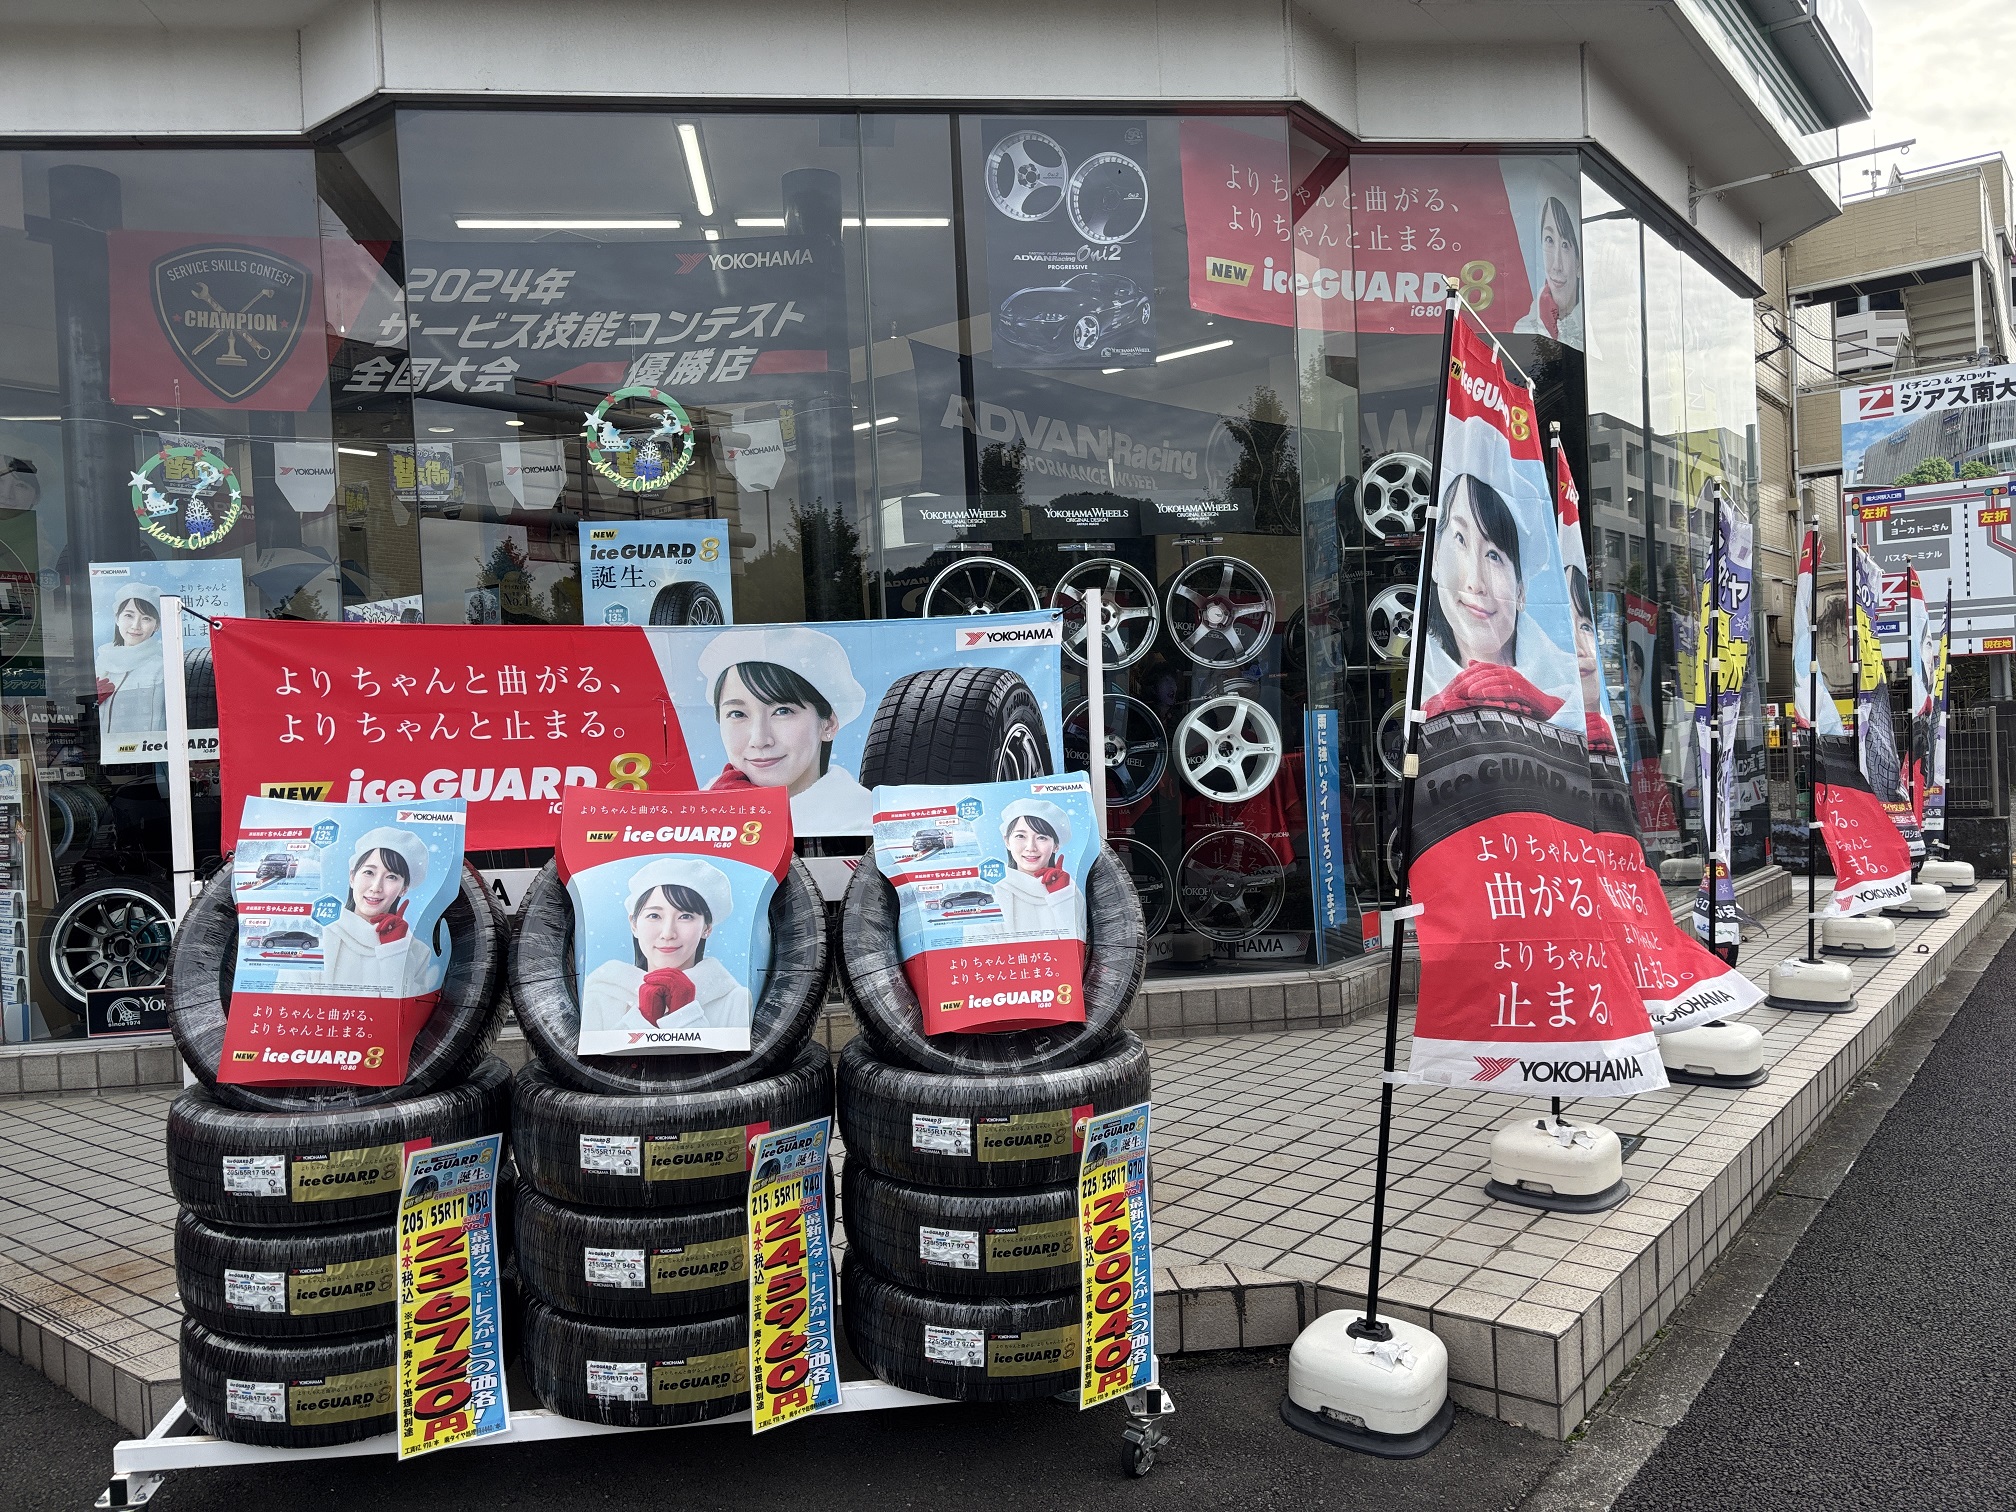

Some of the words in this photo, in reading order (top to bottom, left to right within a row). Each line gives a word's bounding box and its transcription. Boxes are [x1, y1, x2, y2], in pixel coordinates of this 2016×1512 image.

[1224, 164, 1461, 213] よりちゃんと曲がる、
[1227, 205, 1463, 252] よりちゃんと止まる。
[708, 249, 813, 271] YOKOHAMA
[167, 261, 210, 282] SERVICE
[211, 260, 247, 274] SKILLS
[249, 262, 295, 287] CONTEST
[393, 268, 577, 305] 2024年
[1211, 262, 1248, 281] NEW
[1262, 257, 1448, 303] iceGUARD
[1460, 260, 1496, 312] 8
[184, 310, 277, 331] CHAMPION
[1410, 305, 1442, 318] iG80
[373, 301, 806, 350] サービス技能コンテスト
[343, 356, 520, 393] 全国大会
[624, 347, 759, 388] 優勝店
[1900, 378, 1940, 391] パチンコ
[1944, 376, 1952, 385] &
[1955, 370, 1997, 382] スロット
[1511, 406, 1531, 441] 8
[739, 445, 781, 457] YOKOHAMA
[520, 465, 563, 474] YOKOHAMA
[588, 459, 630, 488] Merry
[633, 452, 695, 493] Christmas
[1862, 506, 1888, 519] 左折
[1890, 518, 1915, 526] イトー
[1981, 510, 2008, 523] 左折
[140, 521, 185, 549] Merry
[188, 504, 241, 550] Christmas
[1891, 523, 1949, 536] ヨーカドーさん
[590, 543, 697, 560] iceGUARD
[699, 538, 720, 562] 8
[1884, 551, 1942, 563] バスターミナル
[590, 564, 657, 590] 誕生。
[179, 584, 227, 593] よりちゃんと
[986, 629, 1053, 642] YOKOHAMA
[1983, 639, 2012, 649] 現在地
[275, 665, 622, 698] よりちゃんと曲がる、
[31, 713, 75, 724] ADVAN
[278, 709, 626, 744] よりちゃんと止まる。
[268, 787, 323, 801] NEW
[346, 766, 597, 803] iceGUARD
[609, 753, 652, 790] 8
[1044, 784, 1084, 792] YOKOHAMA
[412, 813, 454, 822] YOKOHAMA
[623, 825, 737, 843] iceGUARD
[739, 821, 763, 845] 8
[1477, 833, 1595, 864] よりちゃんと
[949, 952, 1059, 970] よりちゃんと曲がる、
[1493, 942, 1608, 970] よりちゃんと
[951, 968, 1060, 986] よりちゃんと止まる。
[943, 1002, 961, 1010] NEW
[968, 989, 1054, 1009] iceGUARD
[1057, 984, 1072, 1005] 8
[252, 1005, 374, 1022] よりちゃんと曲がる、
[250, 1023, 373, 1039] よりちゃんと止まる。
[645, 1032, 702, 1042] YOKOHAMA
[262, 1047, 362, 1065] iceGUARD
[363, 1046, 385, 1069] 8
[1519, 1056, 1643, 1082] YOKOHAMA
[984, 1133, 1052, 1148] iceGUARD
[1090, 1121, 1135, 1142] iceGUARD
[761, 1137, 812, 1159] iceGUARD
[413, 1154, 478, 1175] iceGUARD
[651, 1151, 724, 1167] iceGUARD
[299, 1168, 379, 1187] iceGUARD
[1082, 1164, 1126, 1199] 225/55R17
[1128, 1159, 1143, 1180] 97Q
[752, 1181, 801, 1216] 215/55R17
[804, 1174, 820, 1195] 94Q
[1123, 1179, 1145, 1198] No.1
[402, 1196, 465, 1235] 205/55R17
[468, 1191, 489, 1214] 95Q
[799, 1195, 822, 1214] No.1
[461, 1213, 492, 1232] No.1
[1083, 1203, 1095, 1268] 4本税込
[753, 1221, 765, 1285] 4本税込
[992, 1242, 1060, 1258] iceGUARD
[401, 1236, 414, 1304] 4本税込
[657, 1260, 729, 1279] iceGUARD
[296, 1280, 376, 1300] iceGUARD
[994, 1348, 1061, 1364] iceGUARD
[659, 1372, 730, 1391] iceGUARD
[296, 1392, 374, 1411] iceGUARD
